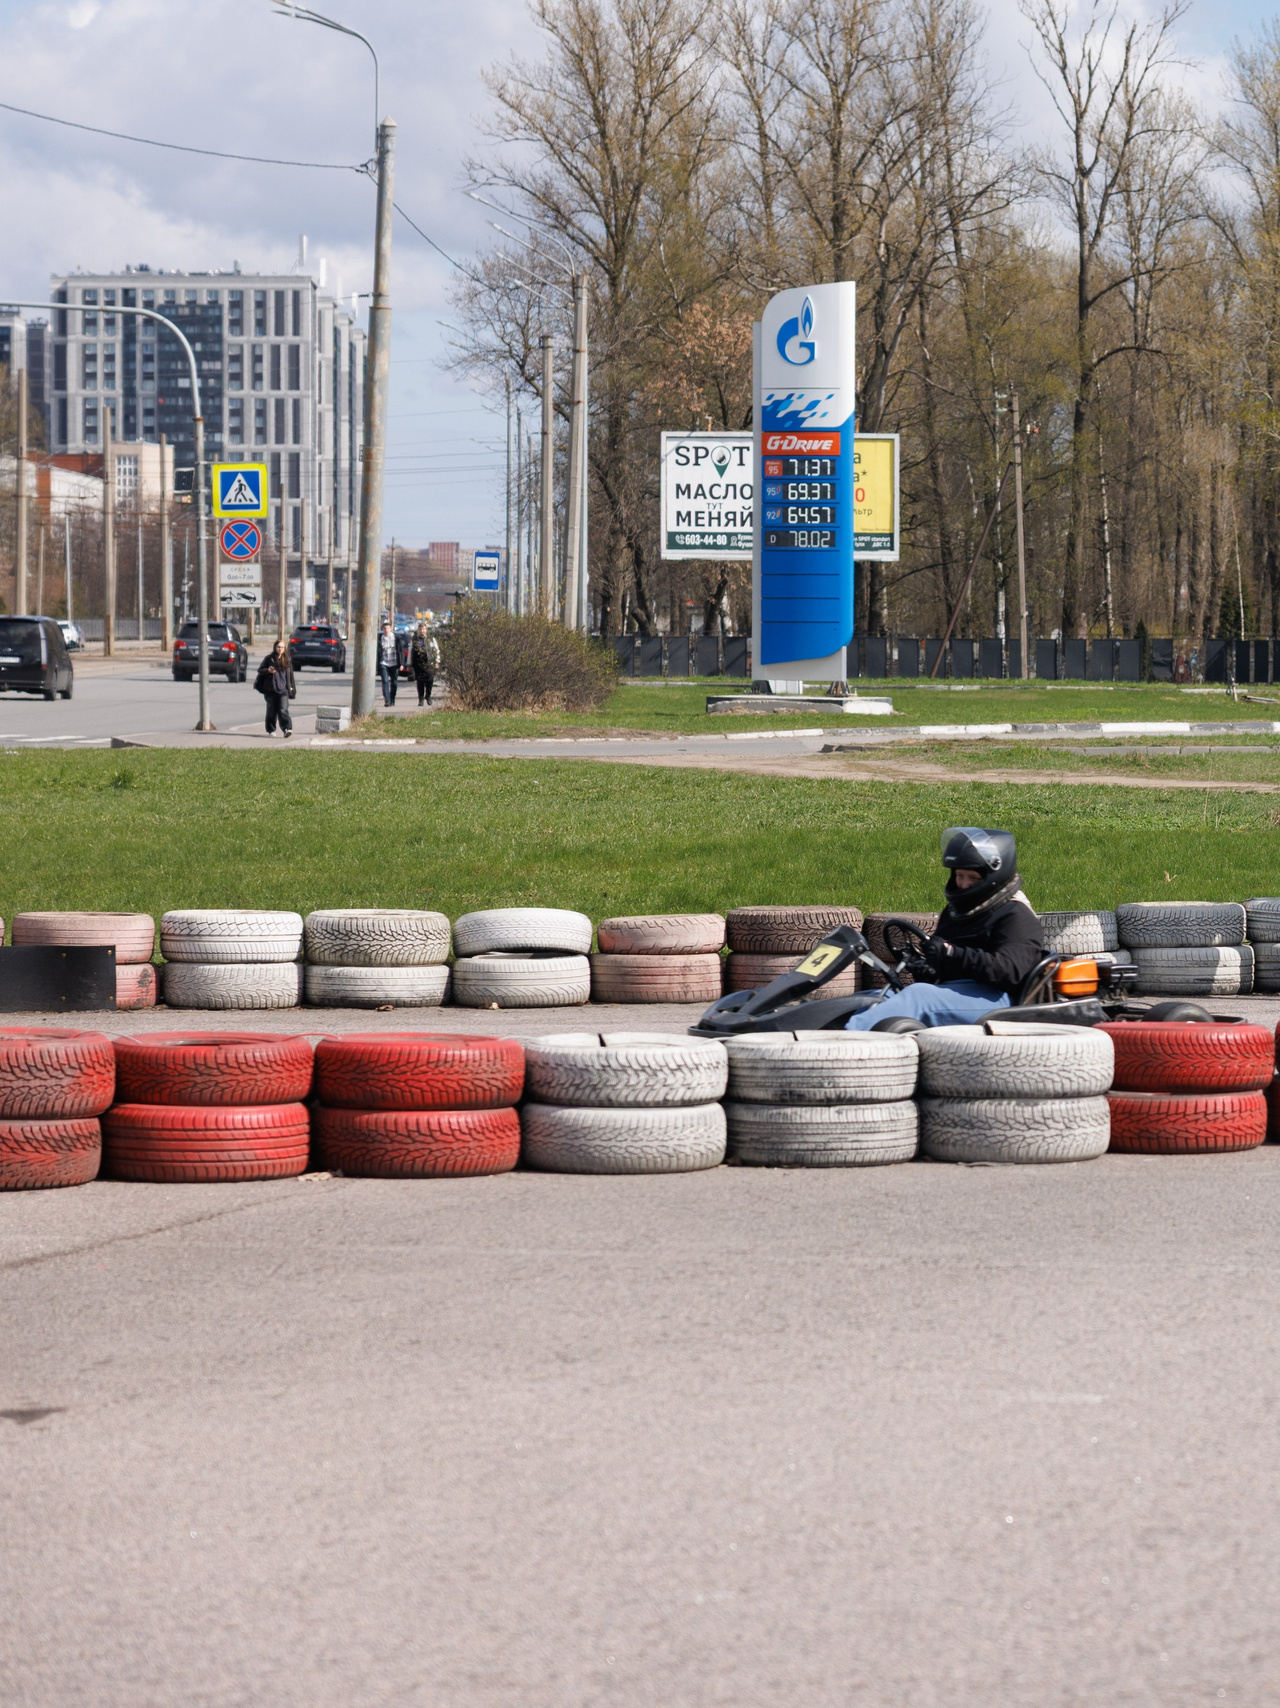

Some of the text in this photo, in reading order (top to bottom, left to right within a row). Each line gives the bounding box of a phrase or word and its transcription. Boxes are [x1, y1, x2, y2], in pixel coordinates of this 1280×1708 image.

[675, 446, 751, 475] SPOT
[789, 459, 831, 476] 71.37
[768, 466, 779, 474] 95
[675, 483, 753, 500] МАСЛО
[766, 487, 777, 496] 95
[788, 483, 831, 500] 69.37
[676, 506, 753, 527] МЕНЯЙ
[766, 511, 777, 520] 92
[788, 507, 831, 524] 64.57
[685, 534, 728, 545] 603-44-80
[770, 535, 777, 543] D
[789, 530, 831, 548] 78.02
[811, 953, 829, 967] 4
